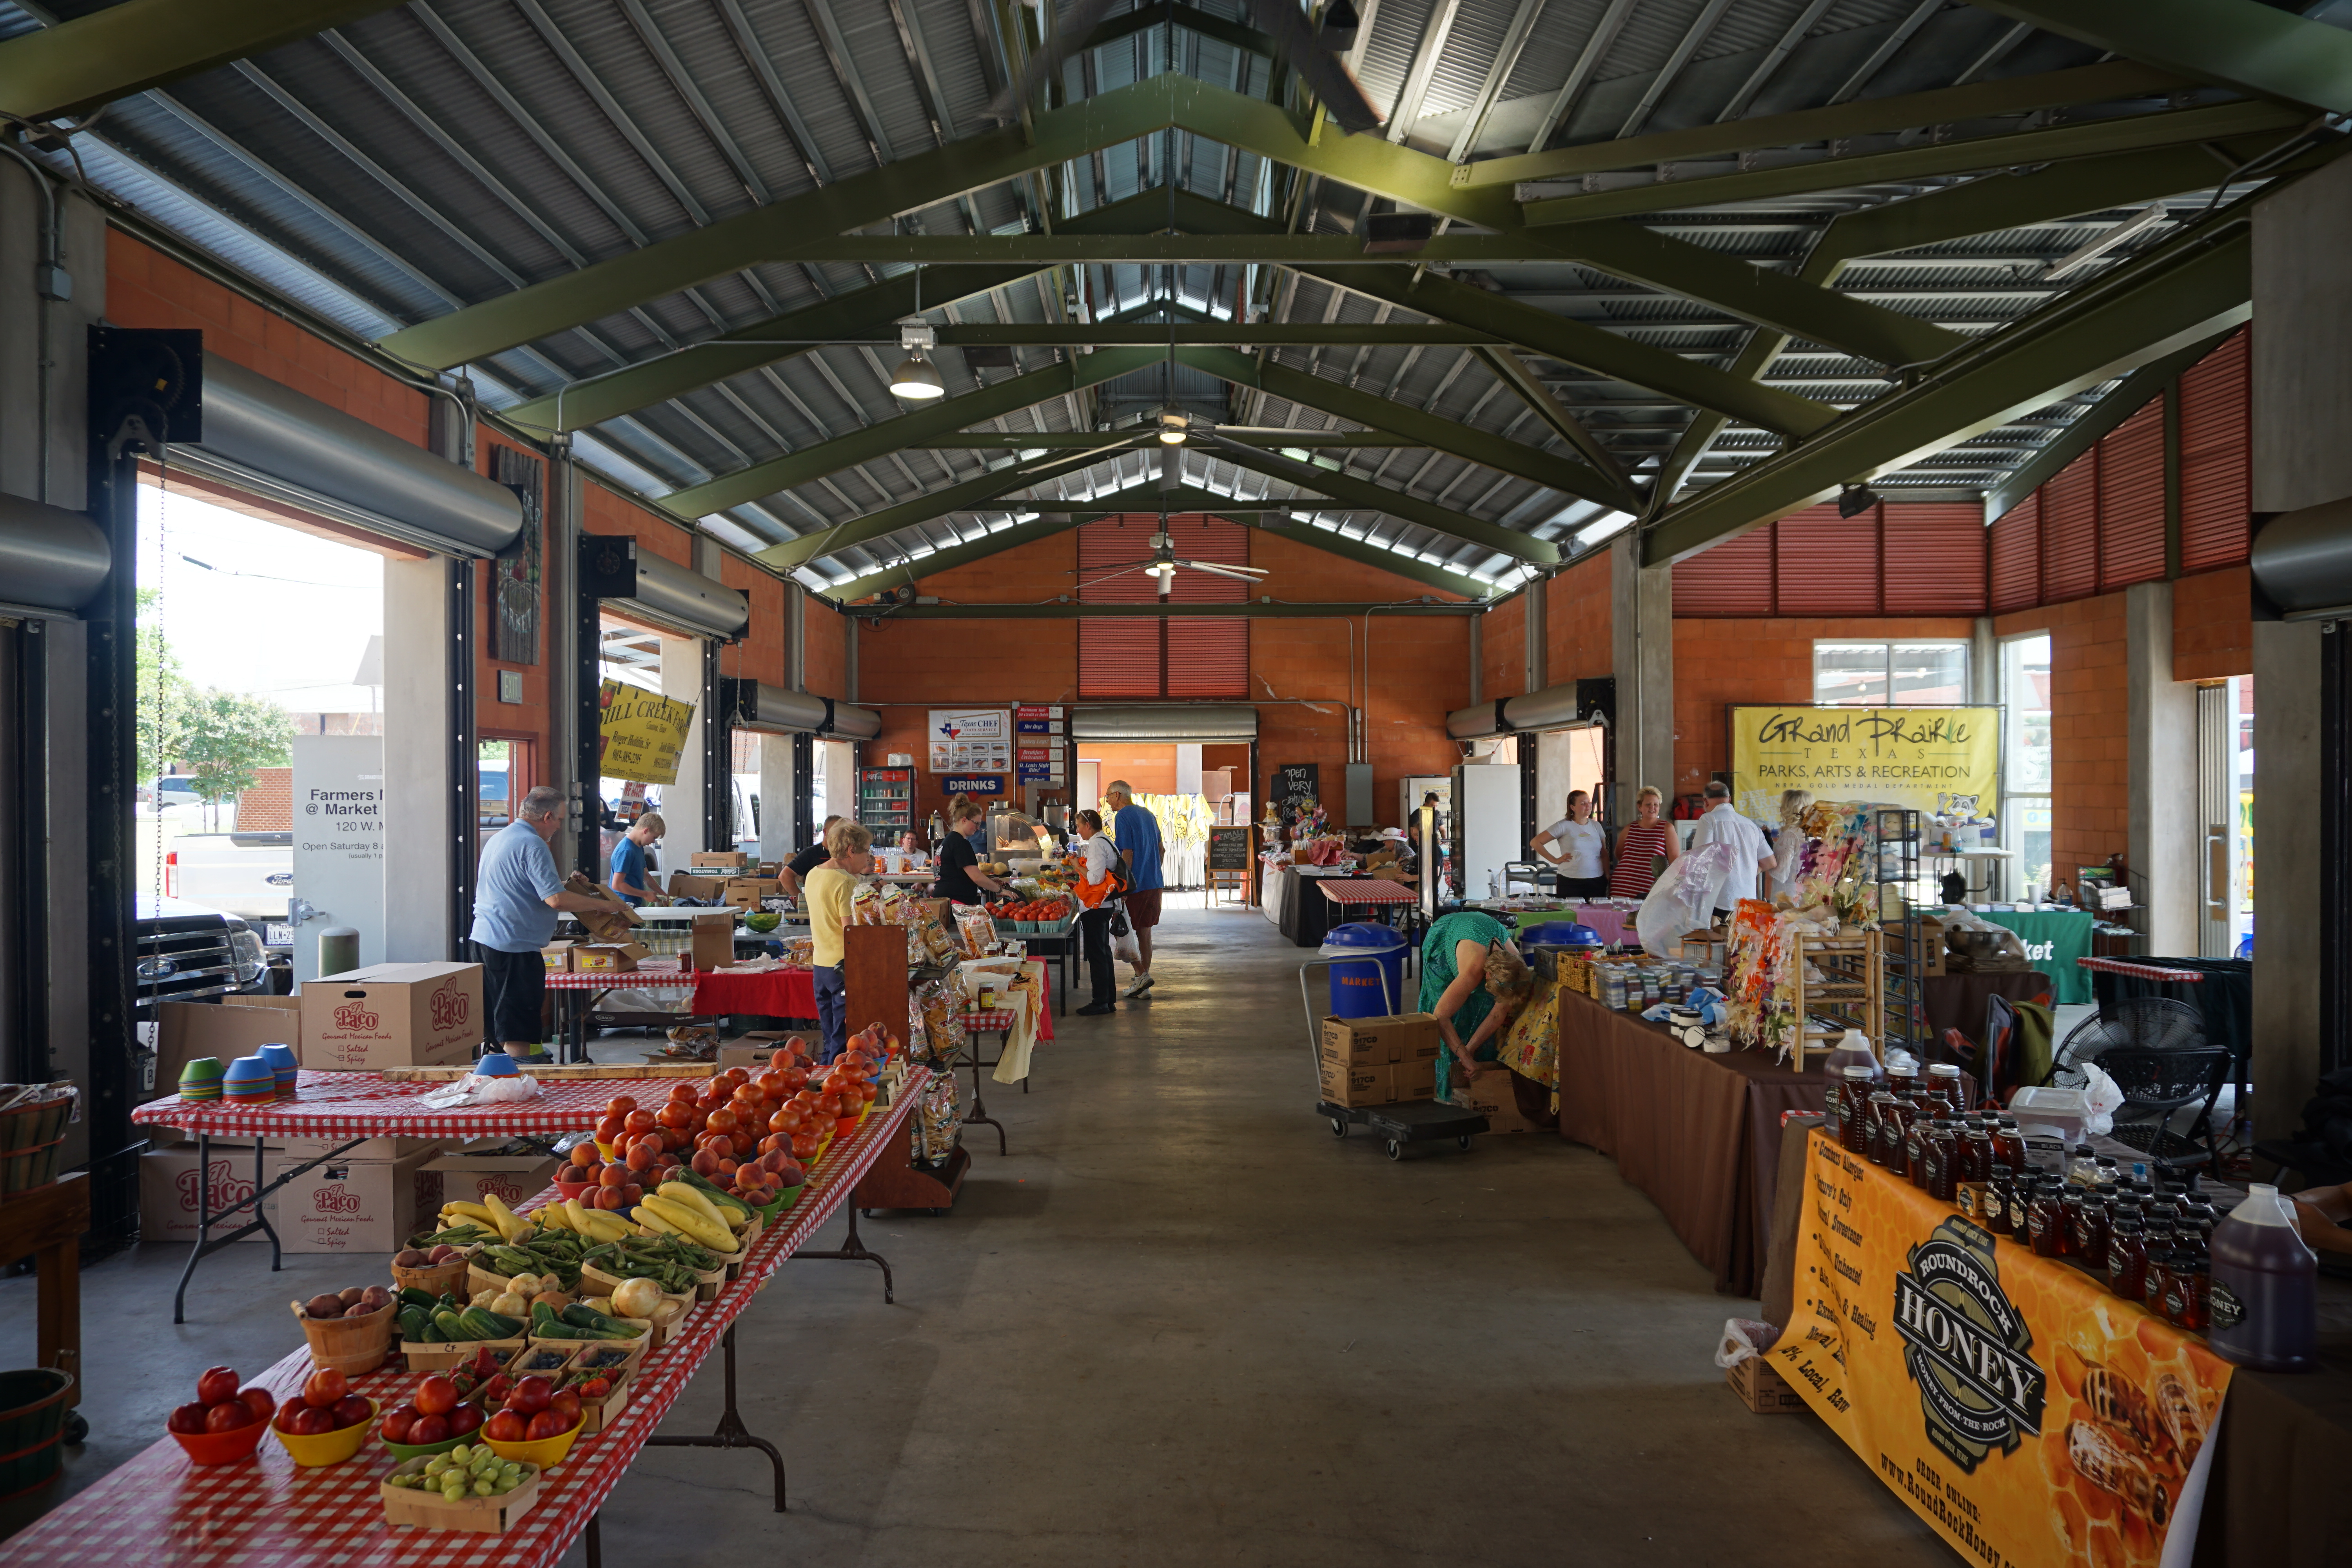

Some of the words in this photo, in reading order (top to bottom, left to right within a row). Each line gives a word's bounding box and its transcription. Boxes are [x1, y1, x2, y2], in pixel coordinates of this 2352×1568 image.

[498, 592, 531, 633] MARKET
[504, 675, 518, 699] EXIT
[637, 701, 675, 723] CREEK
[960, 720, 976, 728] Texas
[1804, 748, 1925, 759] TEXAS
[1759, 765, 1809, 779] PARKS,
[1815, 765, 1851, 778] ARTS
[1856, 766, 1867, 778] &
[1873, 766, 1971, 778] RECREATION
[949, 780, 996, 791] DRINKS
[1740, 788, 1767, 799] BEST
[311, 789, 374, 800] Farmers
[306, 803, 318, 815] @
[325, 803, 378, 815] Market
[1737, 795, 1781, 811] PARK
[1749, 809, 1762, 818] IN
[1765, 807, 1781, 816] TH
[336, 822, 357, 831] 120
[360, 821, 375, 831] W.
[1219, 829, 1245, 840] TAMALE
[303, 842, 327, 852] Open
[330, 842, 370, 851] Saturday
[2022, 939, 2054, 960] ket
[1341, 976, 1381, 987] MARKET
[446, 982, 455, 1000] El
[351, 1004, 361, 1015] El
[432, 993, 467, 1028] Paco
[336, 1010, 377, 1029] Paco
[426, 1040, 444, 1053] Gourmet
[446, 1035, 461, 1046] Mexican
[463, 1028, 474, 1039] Foods
[1324, 1030, 1338, 1040] 917CD
[1354, 1036, 1377, 1044] 917CD
[347, 1055, 365, 1064] Spicy
[1819, 1140, 1841, 1167] Combats
[1843, 1154, 1864, 1182] Allergies
[209, 1162, 229, 1182] El
[331, 1186, 343, 1196] El
[479, 1182, 521, 1201] Paco
[1817, 1172, 1837, 1200] Nature's
[1839, 1188, 1852, 1213] Only
[317, 1192, 358, 1212] Paco
[167, 1220, 200, 1230] Gourme
[301, 1215, 328, 1223] Gourmet
[327, 1228, 350, 1236] Salted
[1831, 1214, 1863, 1248] Sweetener
[1951, 1219, 1967, 1234] ROUND
[1965, 1226, 1980, 1240] ROCK
[327, 1238, 346, 1248] Spicy
[1835, 1253, 1862, 1287] Unheated
[1920, 1253, 2013, 1336] ROUNDROCK
[1843, 1298, 1849, 1317] &
[1851, 1304, 1877, 1341] Healing
[445, 1344, 457, 1352] CF
[1900, 1284, 2037, 1410] HONEY
[1798, 1359, 1830, 1393] Local,
[1827, 1387, 1851, 1413] Raw
[1982, 1416, 2007, 1432] ROCK
[1931, 1426, 1948, 1446] ROUND
[1956, 1448, 1969, 1466] TEXAS
[1916, 1457, 1941, 1492] ORDER
[1946, 1482, 1981, 1525] ONLINE:
